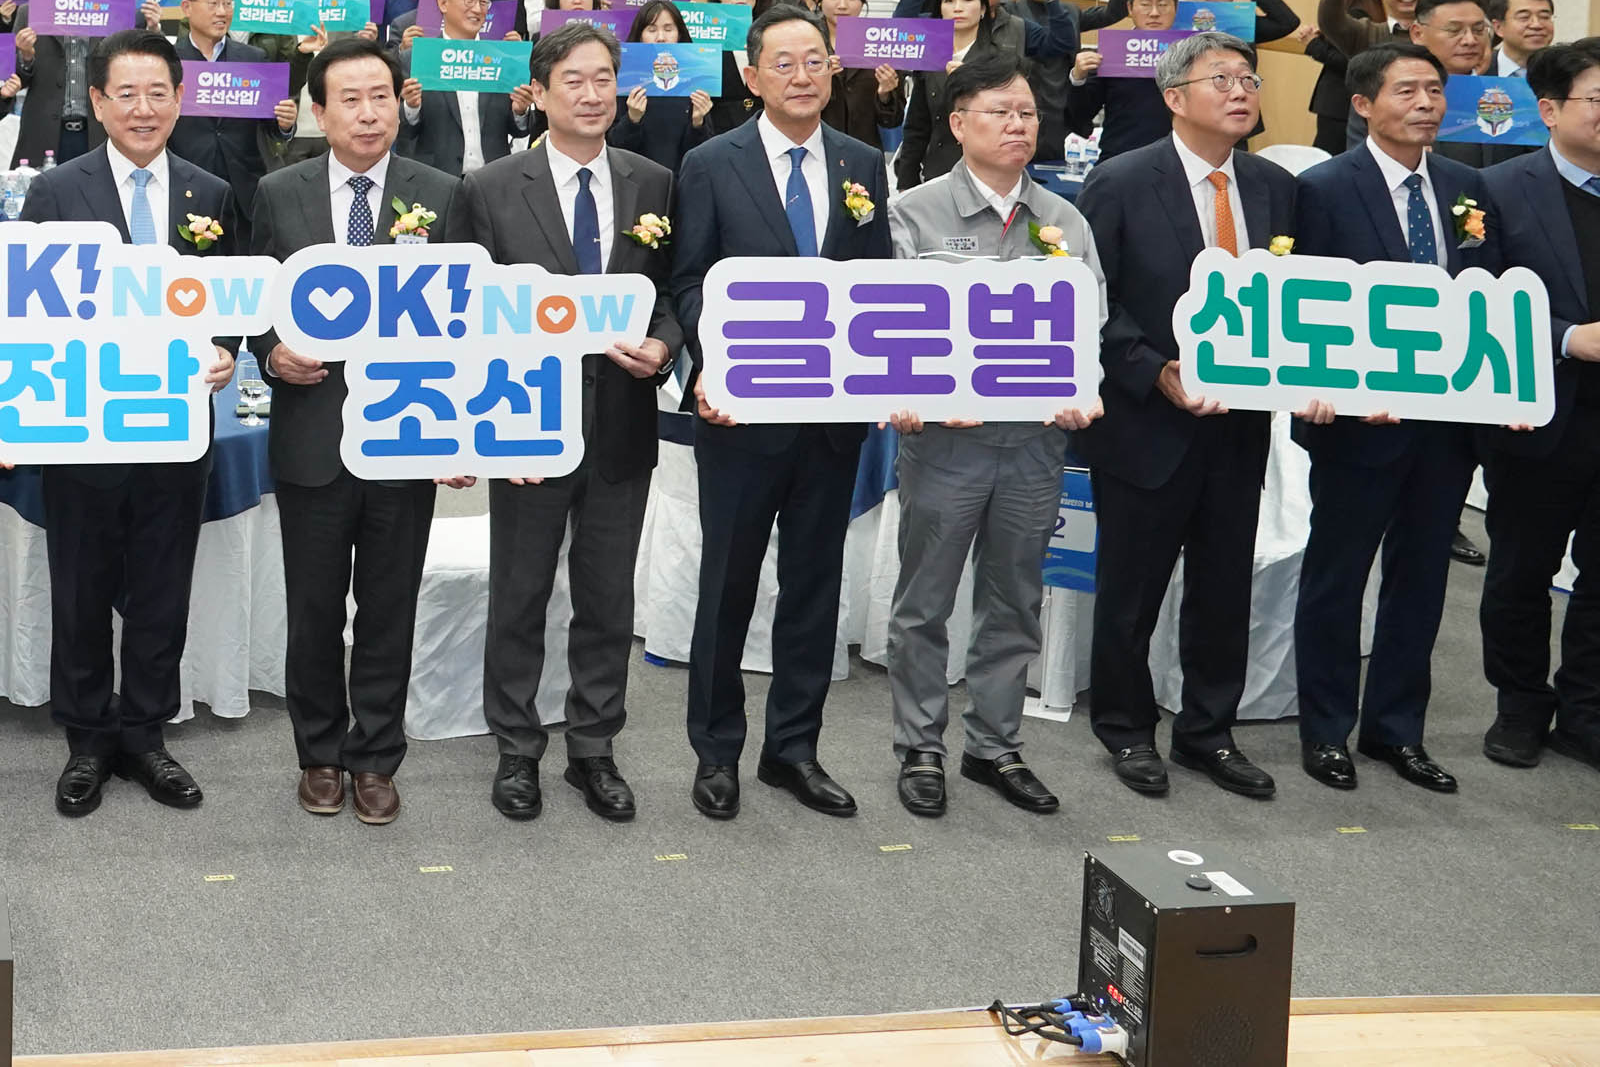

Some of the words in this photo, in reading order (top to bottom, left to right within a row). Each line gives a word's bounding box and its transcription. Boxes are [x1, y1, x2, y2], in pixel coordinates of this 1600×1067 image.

[85, 1, 110, 11] Now
[54, 11, 109, 27] 조선산업!
[239, 7, 294, 24] 전라남도!
[865, 27, 898, 42] OK!
[898, 32, 926, 43] Now
[864, 43, 926, 60] 조선산업!
[1126, 38, 1158, 53] OK!
[441, 49, 474, 64] OK!
[474, 53, 502, 65] Now
[197, 71, 232, 87] OK!
[232, 77, 261, 88] Now
[440, 65, 502, 82] 전라남도!
[196, 88, 260, 106] 조선산업!
[111, 265, 266, 320] Now
[290, 263, 472, 341] OK!
[482, 284, 636, 336] Now
[721, 279, 1078, 399] 글로벌
[1190, 270, 1538, 404] 선도도시
[360, 355, 565, 458] 조선
